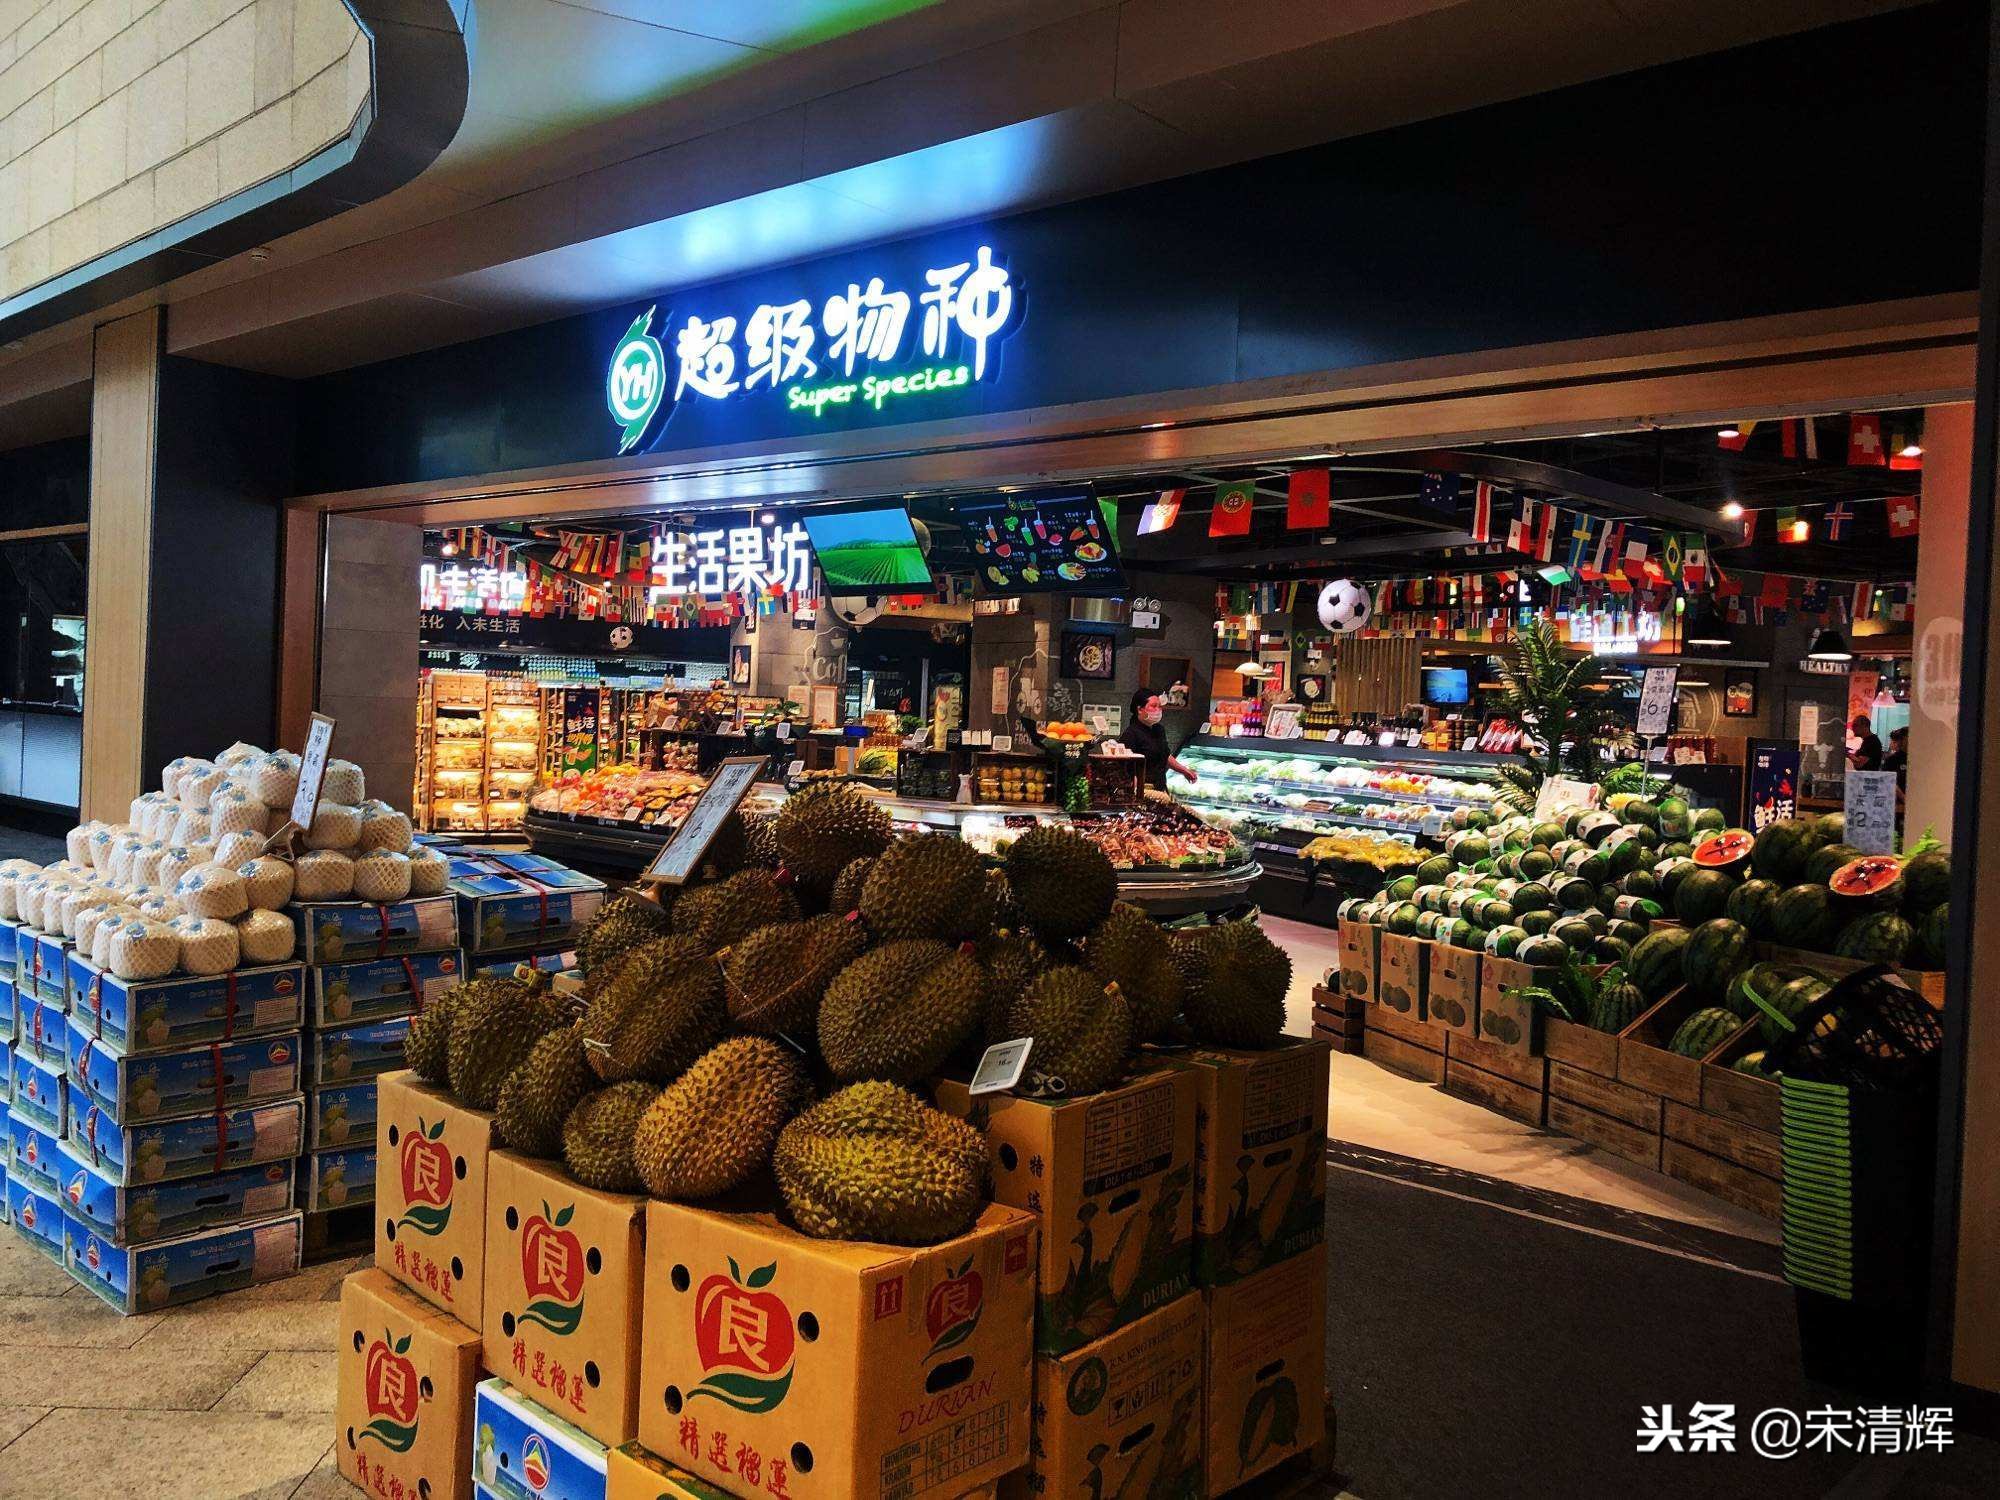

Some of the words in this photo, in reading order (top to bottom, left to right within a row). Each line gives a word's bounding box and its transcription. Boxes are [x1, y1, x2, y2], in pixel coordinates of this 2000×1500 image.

[674, 245, 1012, 402] 超级物种
[618, 359, 656, 402] YH
[787, 381, 858, 417] Super
[862, 364, 970, 410] Species
[651, 523, 810, 597] 生活果坊
[1799, 660, 1850, 674] HEALTHY
[413, 1146, 442, 1204] 良
[536, 1233, 571, 1301] 良
[1142, 1271, 1191, 1309] DURIAN
[717, 1296, 771, 1372] 良
[377, 1359, 408, 1419] 良
[898, 1371, 996, 1434] DURIAN
